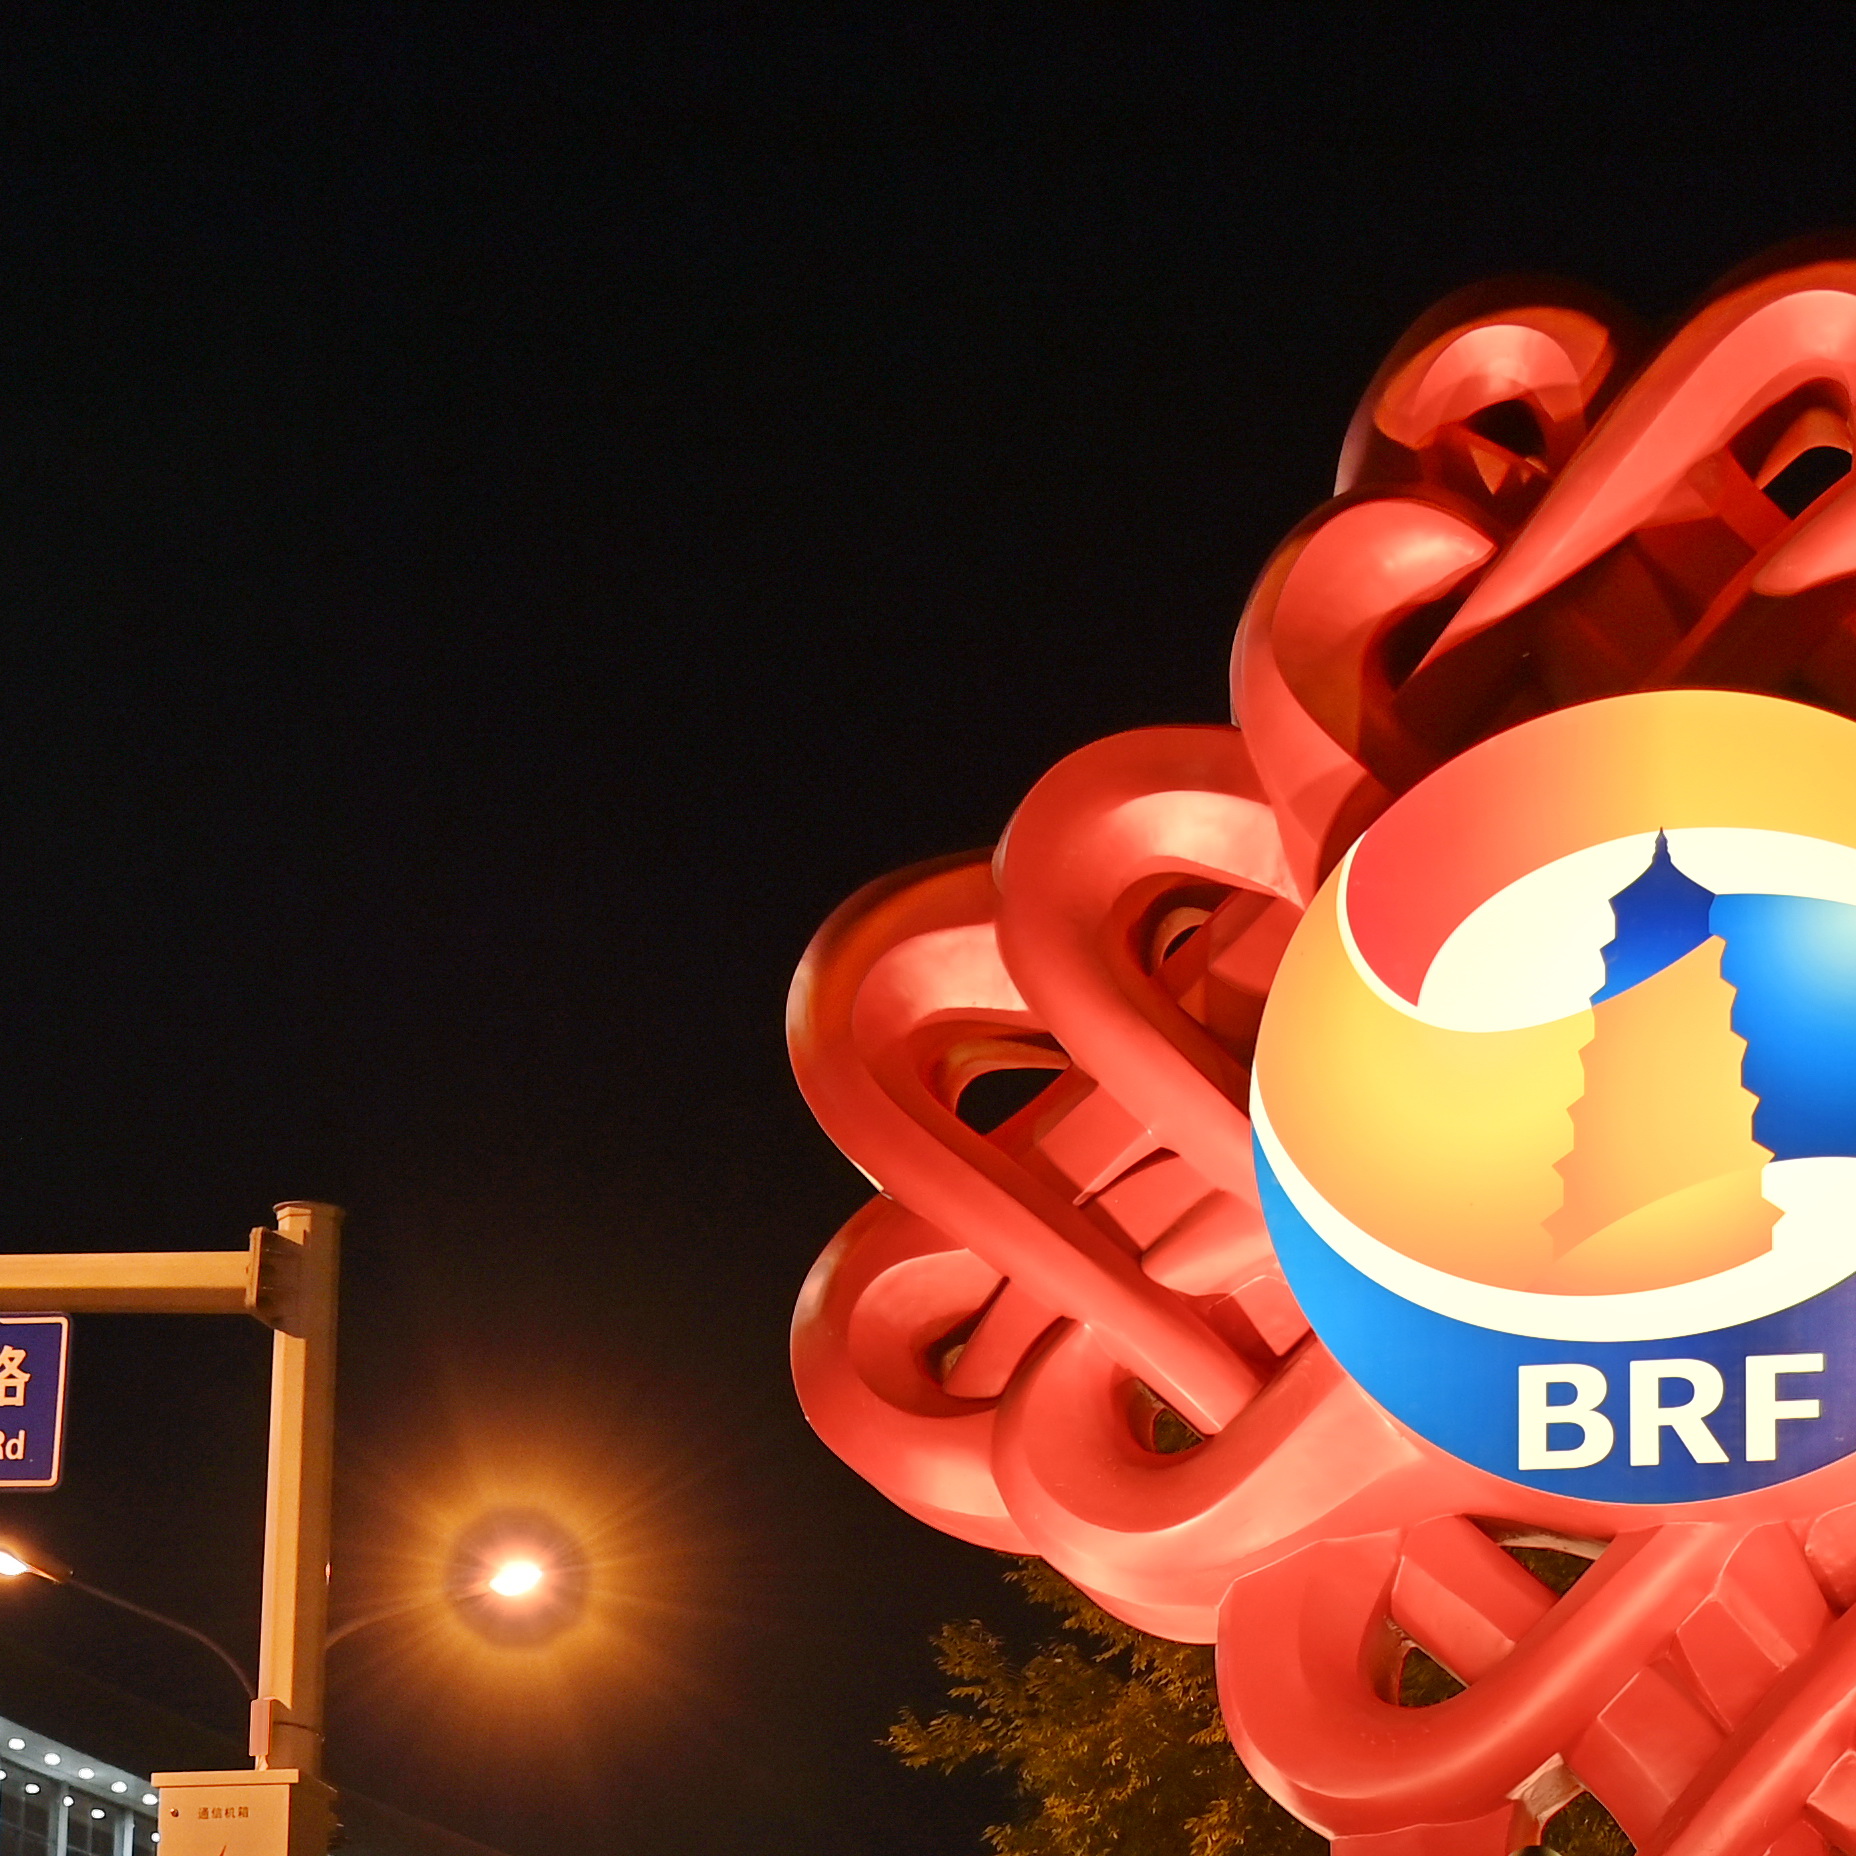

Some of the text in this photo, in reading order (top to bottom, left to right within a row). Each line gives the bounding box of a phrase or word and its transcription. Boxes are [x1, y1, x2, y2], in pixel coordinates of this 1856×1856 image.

[1518, 1353, 1825, 1471] BRF
[199, 1806, 250, 1819] 通信机箱
